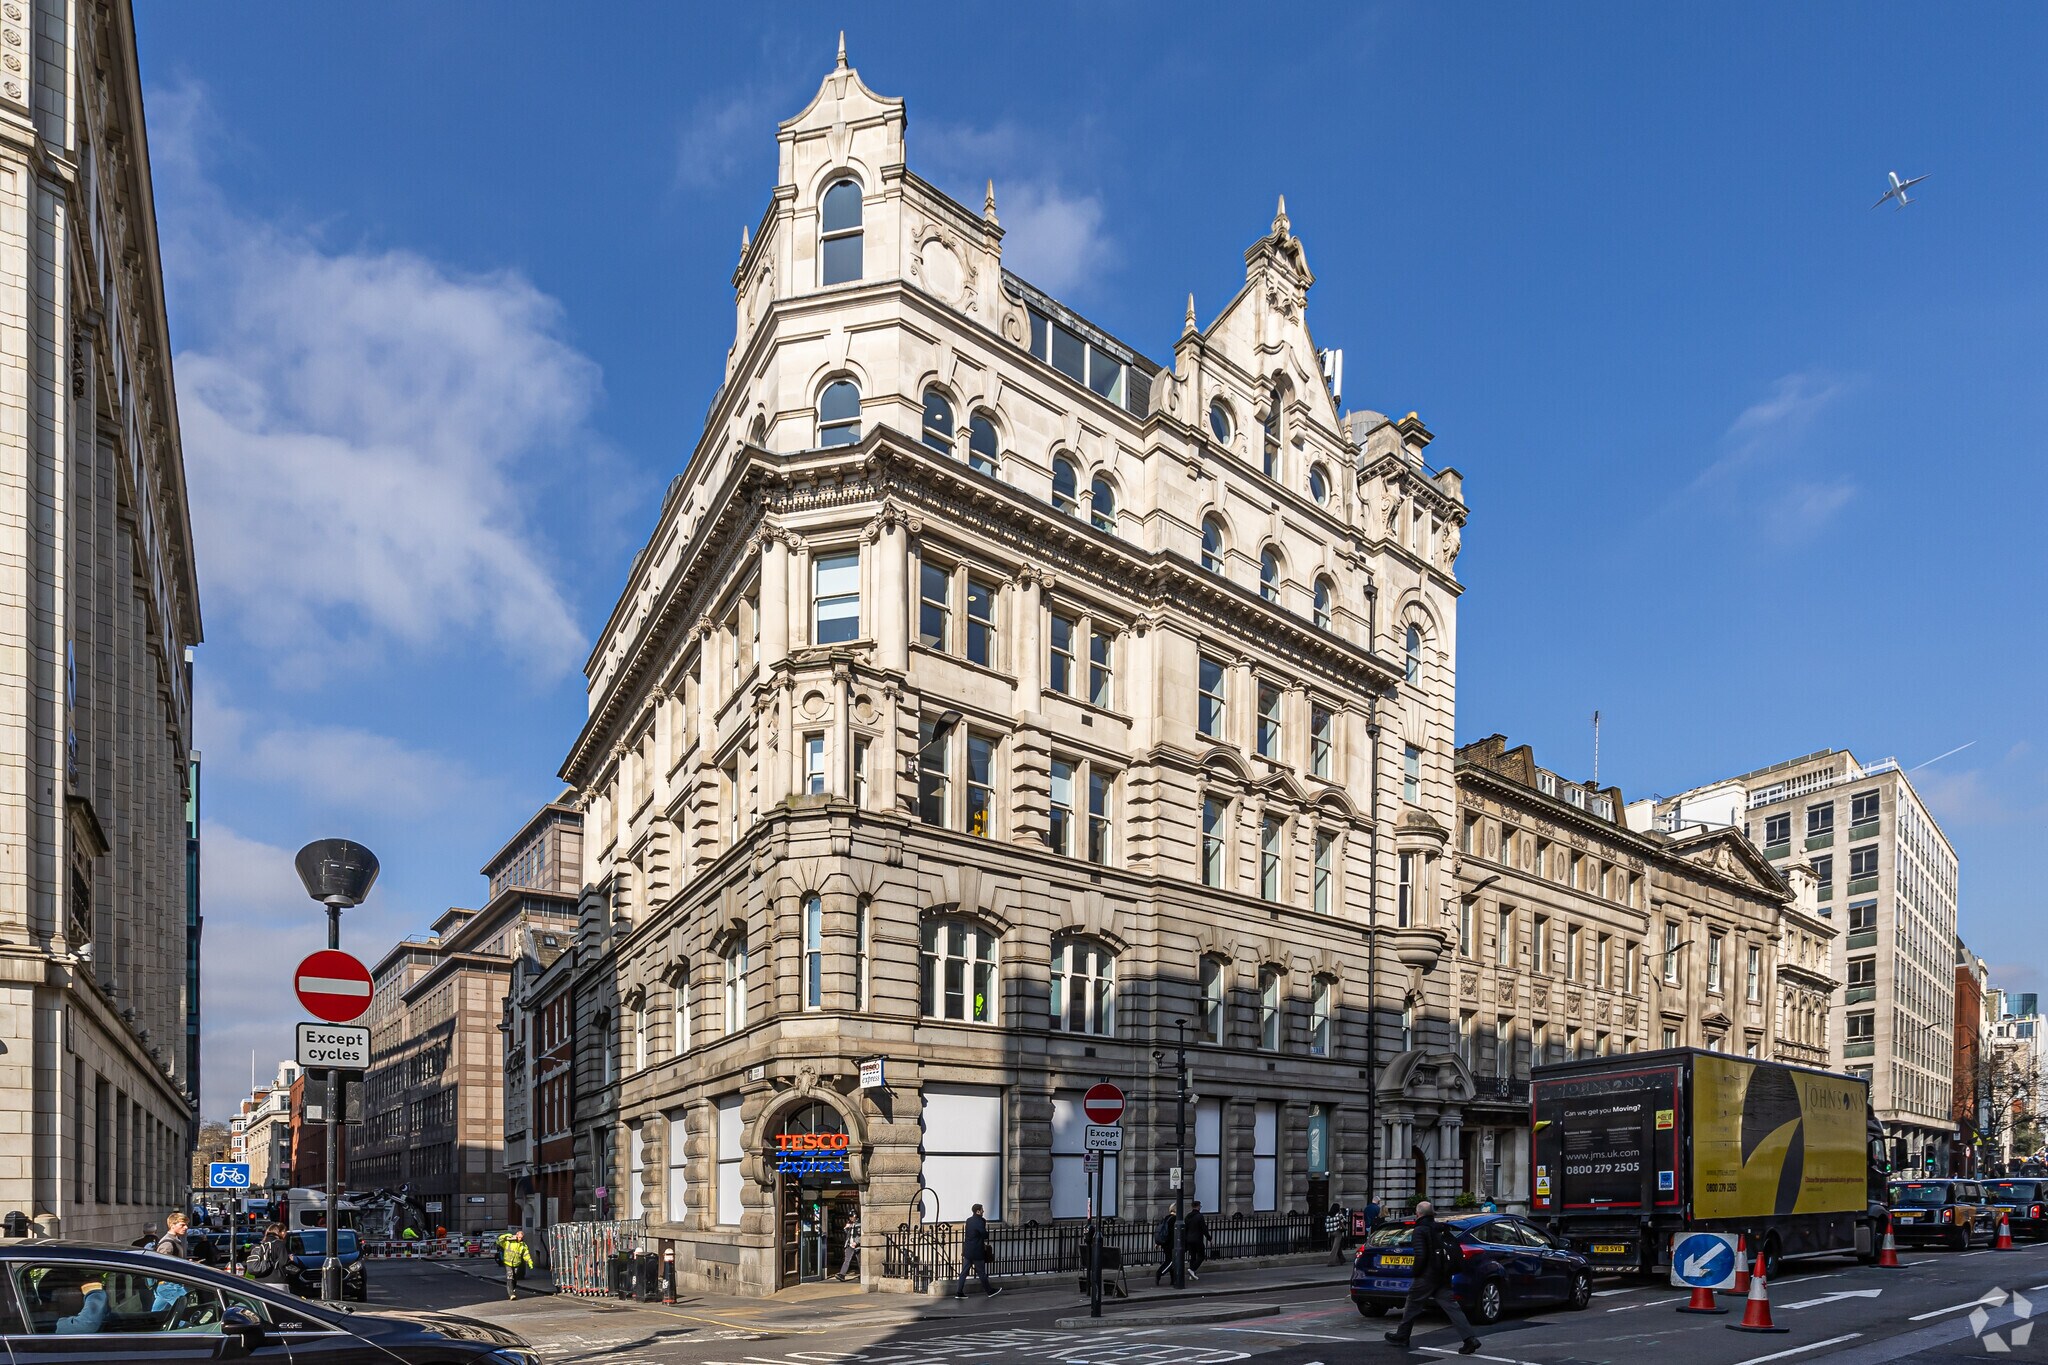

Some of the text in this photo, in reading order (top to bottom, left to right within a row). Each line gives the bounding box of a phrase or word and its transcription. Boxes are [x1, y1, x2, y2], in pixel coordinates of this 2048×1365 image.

[306, 1031, 363, 1047] Except
[308, 1048, 360, 1061] cycles
[862, 1063, 880, 1072] TESCO
[862, 1075, 880, 1084] express
[1562, 1077, 1645, 1098] JOHNSONS
[1804, 1082, 1864, 1112] JOHNSONS
[1588, 1108, 1599, 1116] get
[1612, 1104, 1641, 1113] Moving?
[1090, 1129, 1119, 1138] Except
[776, 1133, 849, 1150] TESCO
[1090, 1139, 1117, 1147] cycles
[1566, 1149, 1640, 1160] www.jms.uk.com
[777, 1160, 845, 1178] express
[1566, 1162, 1640, 1175] 0800 279 2505
[1706, 1183, 1718, 1192] 0800
[1385, 1256, 1400, 1264] LV15
[861, 1328, 1074, 1352] ENTRY
[1023, 1342, 1252, 1365] KEEP
